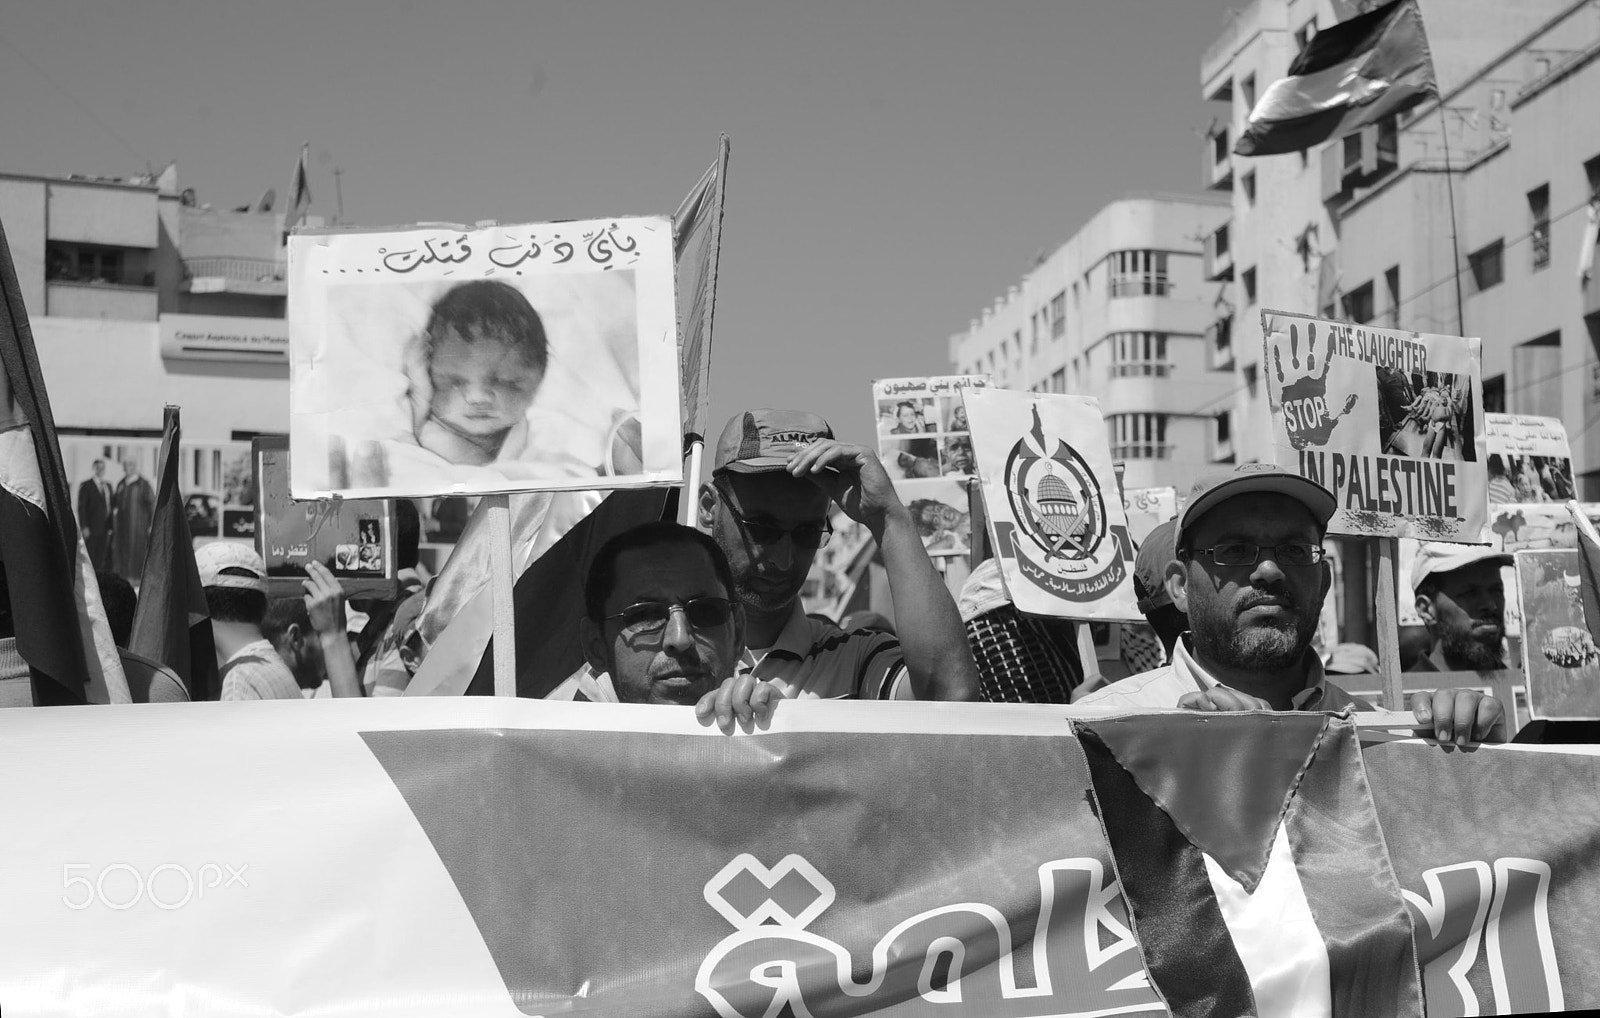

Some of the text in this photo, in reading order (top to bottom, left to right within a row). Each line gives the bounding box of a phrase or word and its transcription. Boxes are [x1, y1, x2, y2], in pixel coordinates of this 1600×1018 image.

[1330, 325, 1428, 376] THE SLAUGHTER
[884, 381, 927, 396] صهيون
[953, 377, 986, 393] جائم
[1283, 396, 1325, 433] STOP
[1332, 452, 1458, 518] PALESTINE
